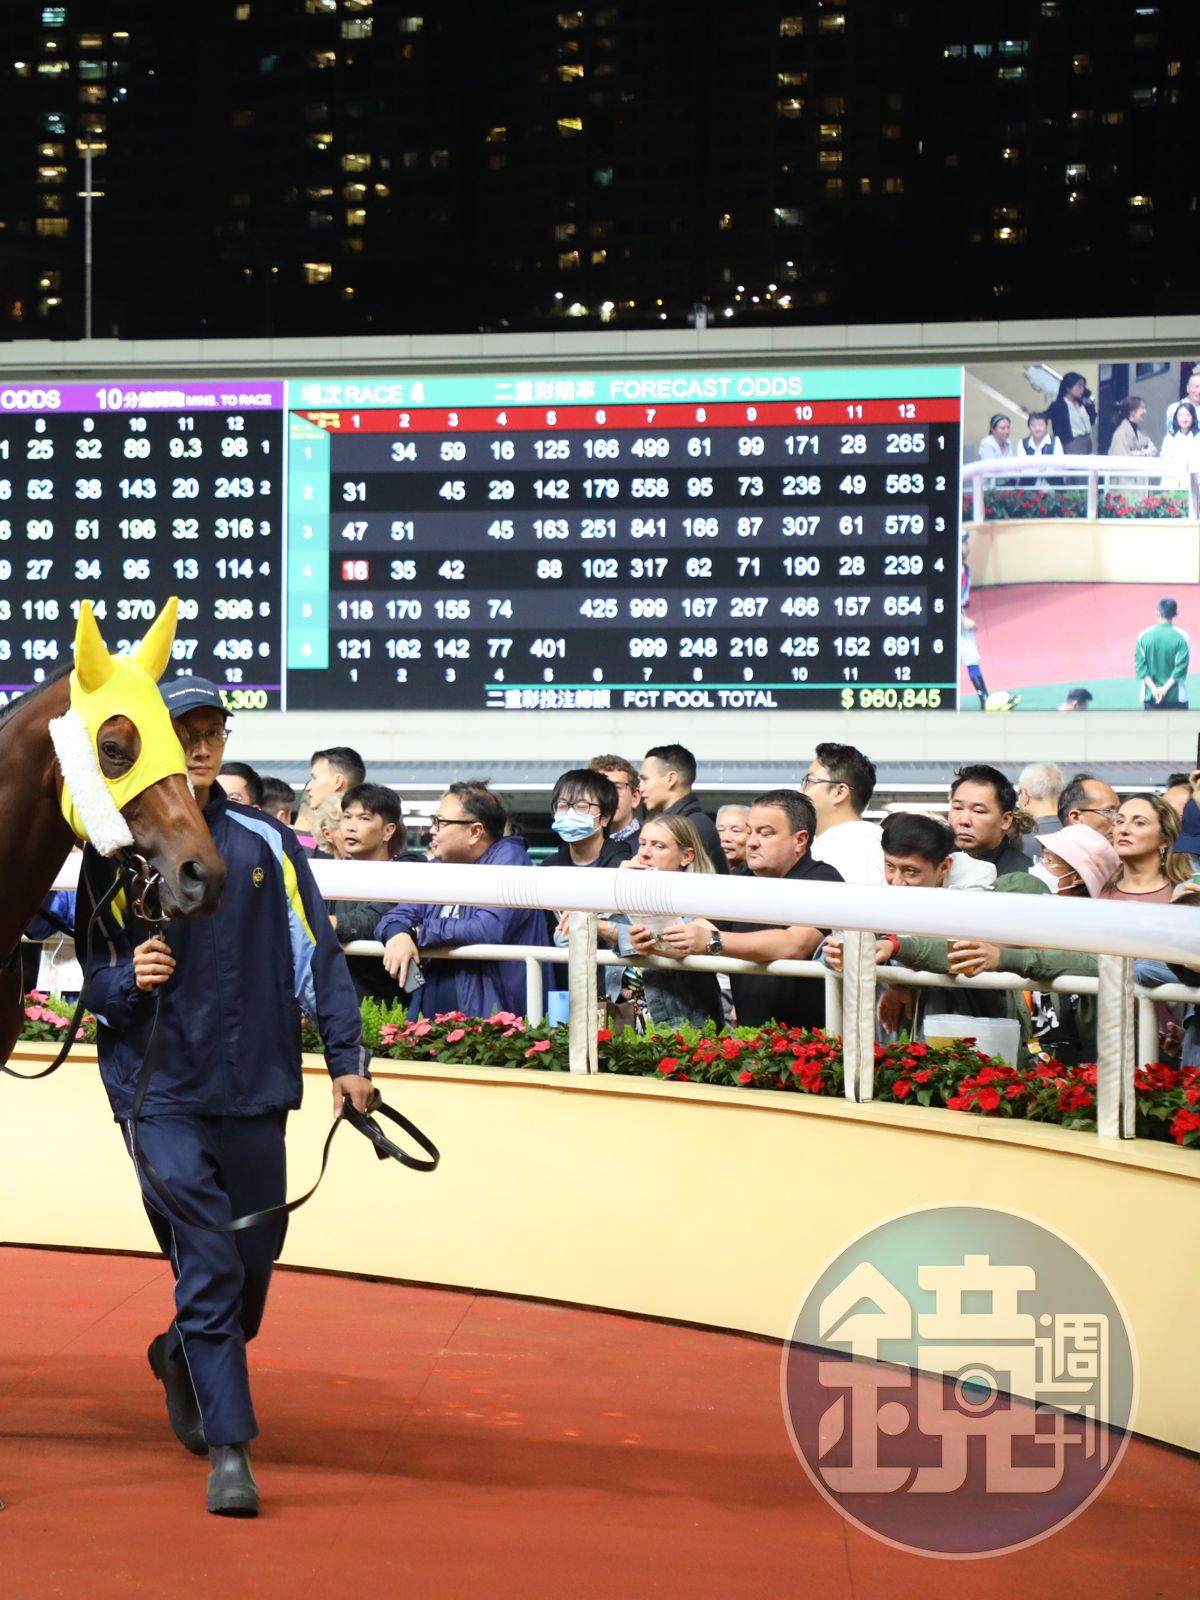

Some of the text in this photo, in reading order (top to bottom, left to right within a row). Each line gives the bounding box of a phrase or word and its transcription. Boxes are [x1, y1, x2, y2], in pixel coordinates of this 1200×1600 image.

[610, 377, 733, 399] FORECAST
[737, 375, 805, 397] ODDS
[2, 389, 63, 410] ODDS
[27, 440, 53, 459] 25
[76, 439, 102, 459] 32
[124, 438, 150, 458] 89
[170, 438, 202, 458] 9.3
[221, 437, 248, 457] 98
[262, 440, 269, 453] 1
[392, 434, 944, 461] 34 59 16 125 166 499 61 99 171 28 265 1
[27, 479, 53, 499] 52
[75, 479, 102, 499] 38
[119, 478, 156, 498] 143
[172, 478, 199, 498] 20
[215, 478, 254, 498] 243
[259, 480, 271, 495] 2
[343, 474, 945, 501] 31 45 29 142 179 558 95 73 236 49 563 2
[27, 520, 53, 540] 90
[75, 520, 99, 540] 51
[119, 519, 156, 539] 196
[172, 519, 198, 539] 32
[215, 518, 254, 538] 316
[259, 520, 271, 535] 3
[342, 515, 945, 541] 47 51 45 163 251 841 166 87 307 61 579 3
[623, 689, 660, 707] FCT
[663, 689, 715, 707] POOL
[717, 689, 778, 707] TOTAL
[841, 687, 855, 708] $
[859, 687, 942, 711] 960,845
